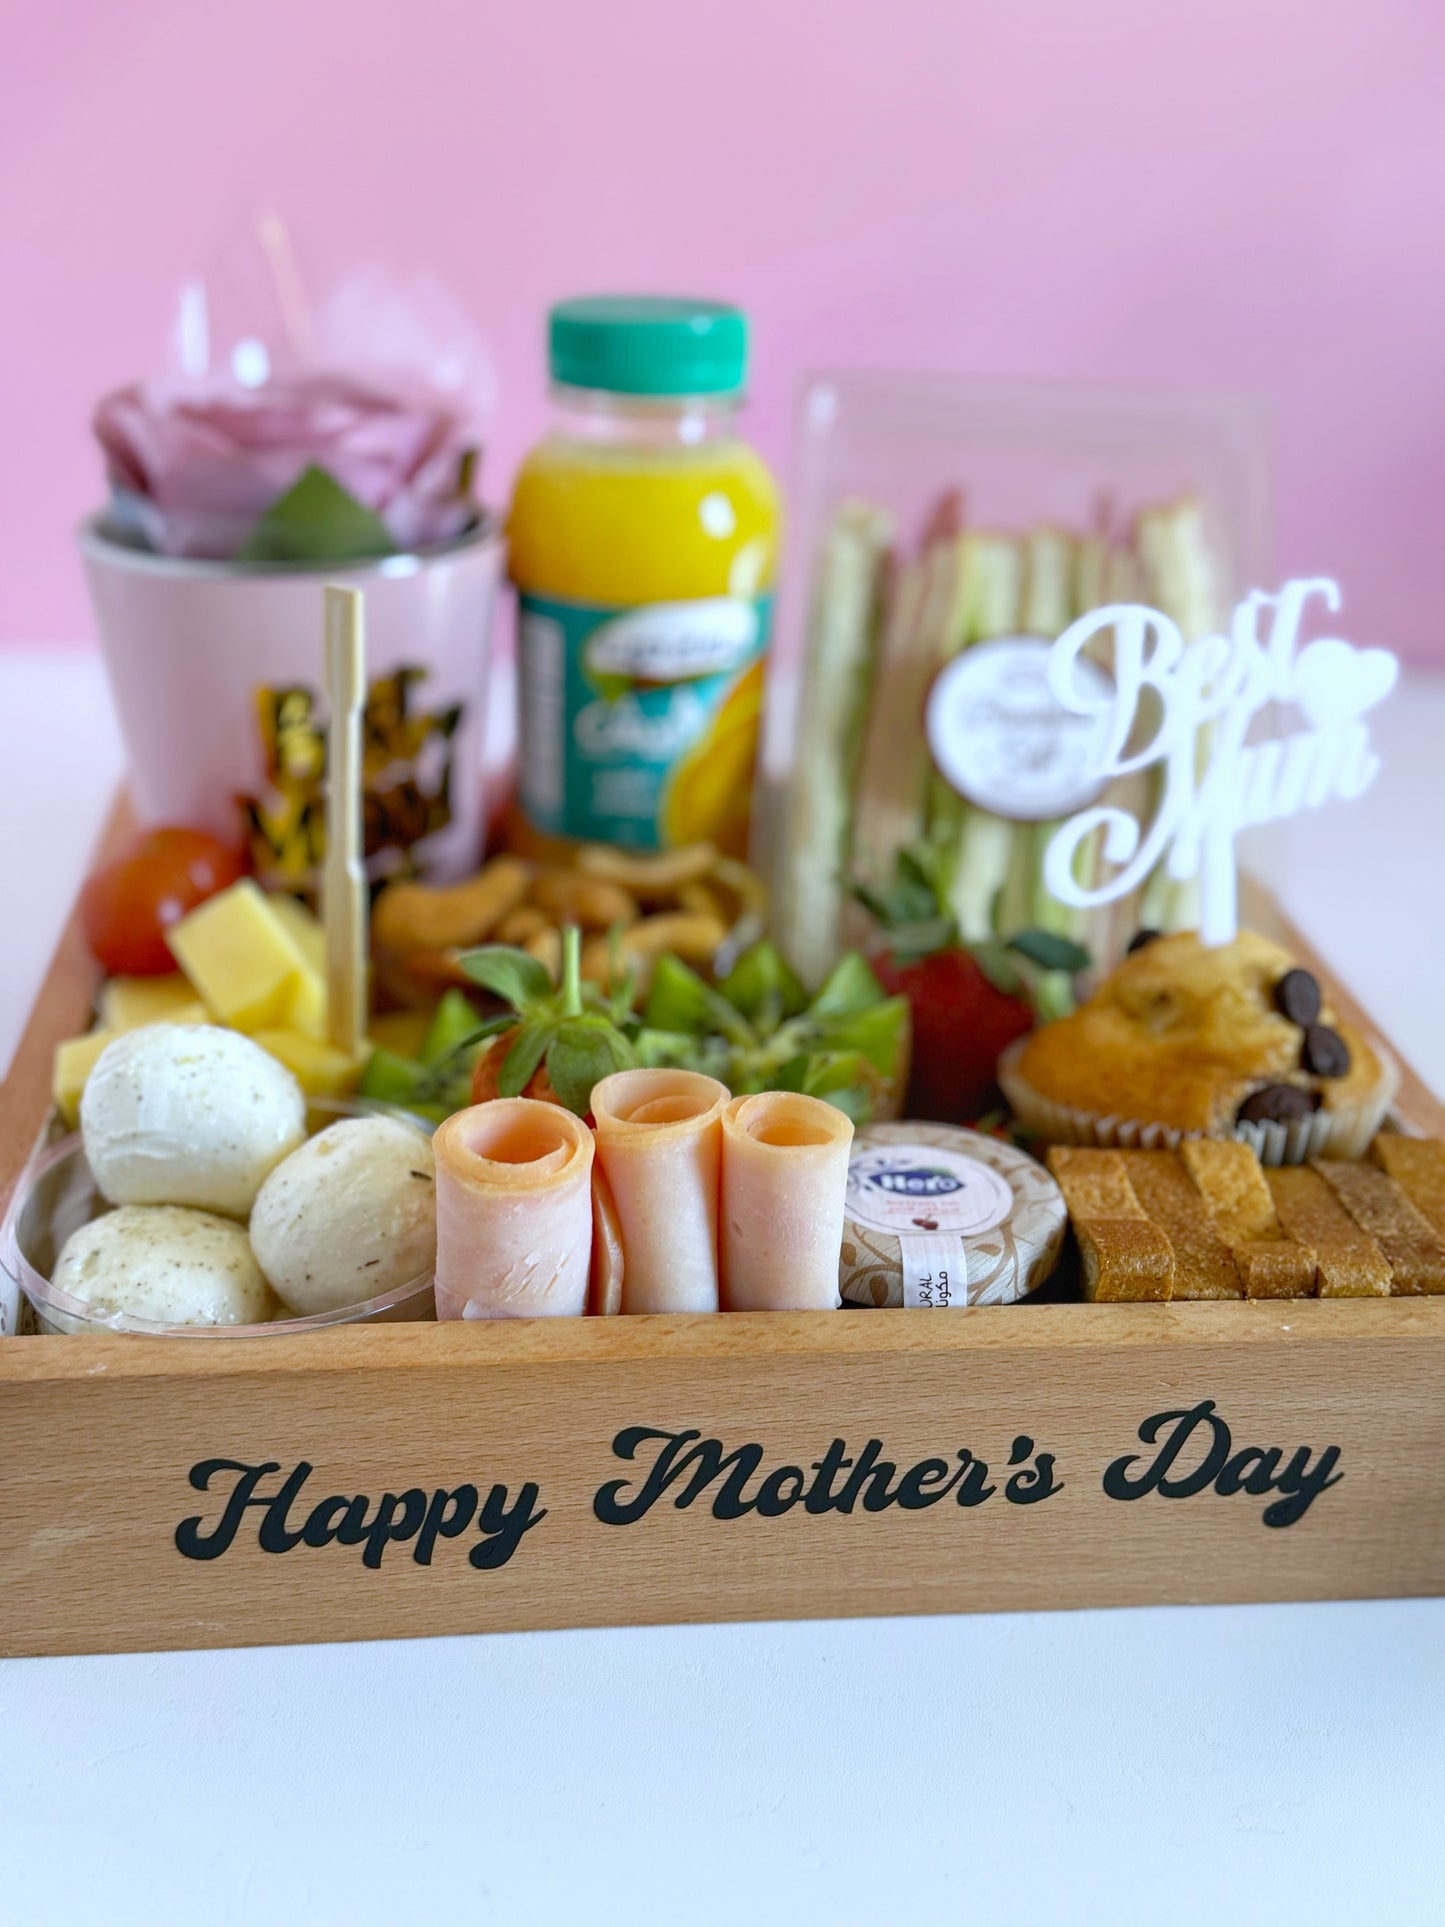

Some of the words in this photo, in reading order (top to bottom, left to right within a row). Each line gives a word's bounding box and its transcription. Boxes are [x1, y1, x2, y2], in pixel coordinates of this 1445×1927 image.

[1047, 577, 1342, 776] Best
[880, 1174, 958, 1192] Hero
[174, 1458, 548, 1569] Happy
[593, 1426, 1065, 1526] Mother's
[1102, 1400, 1345, 1528] Day
